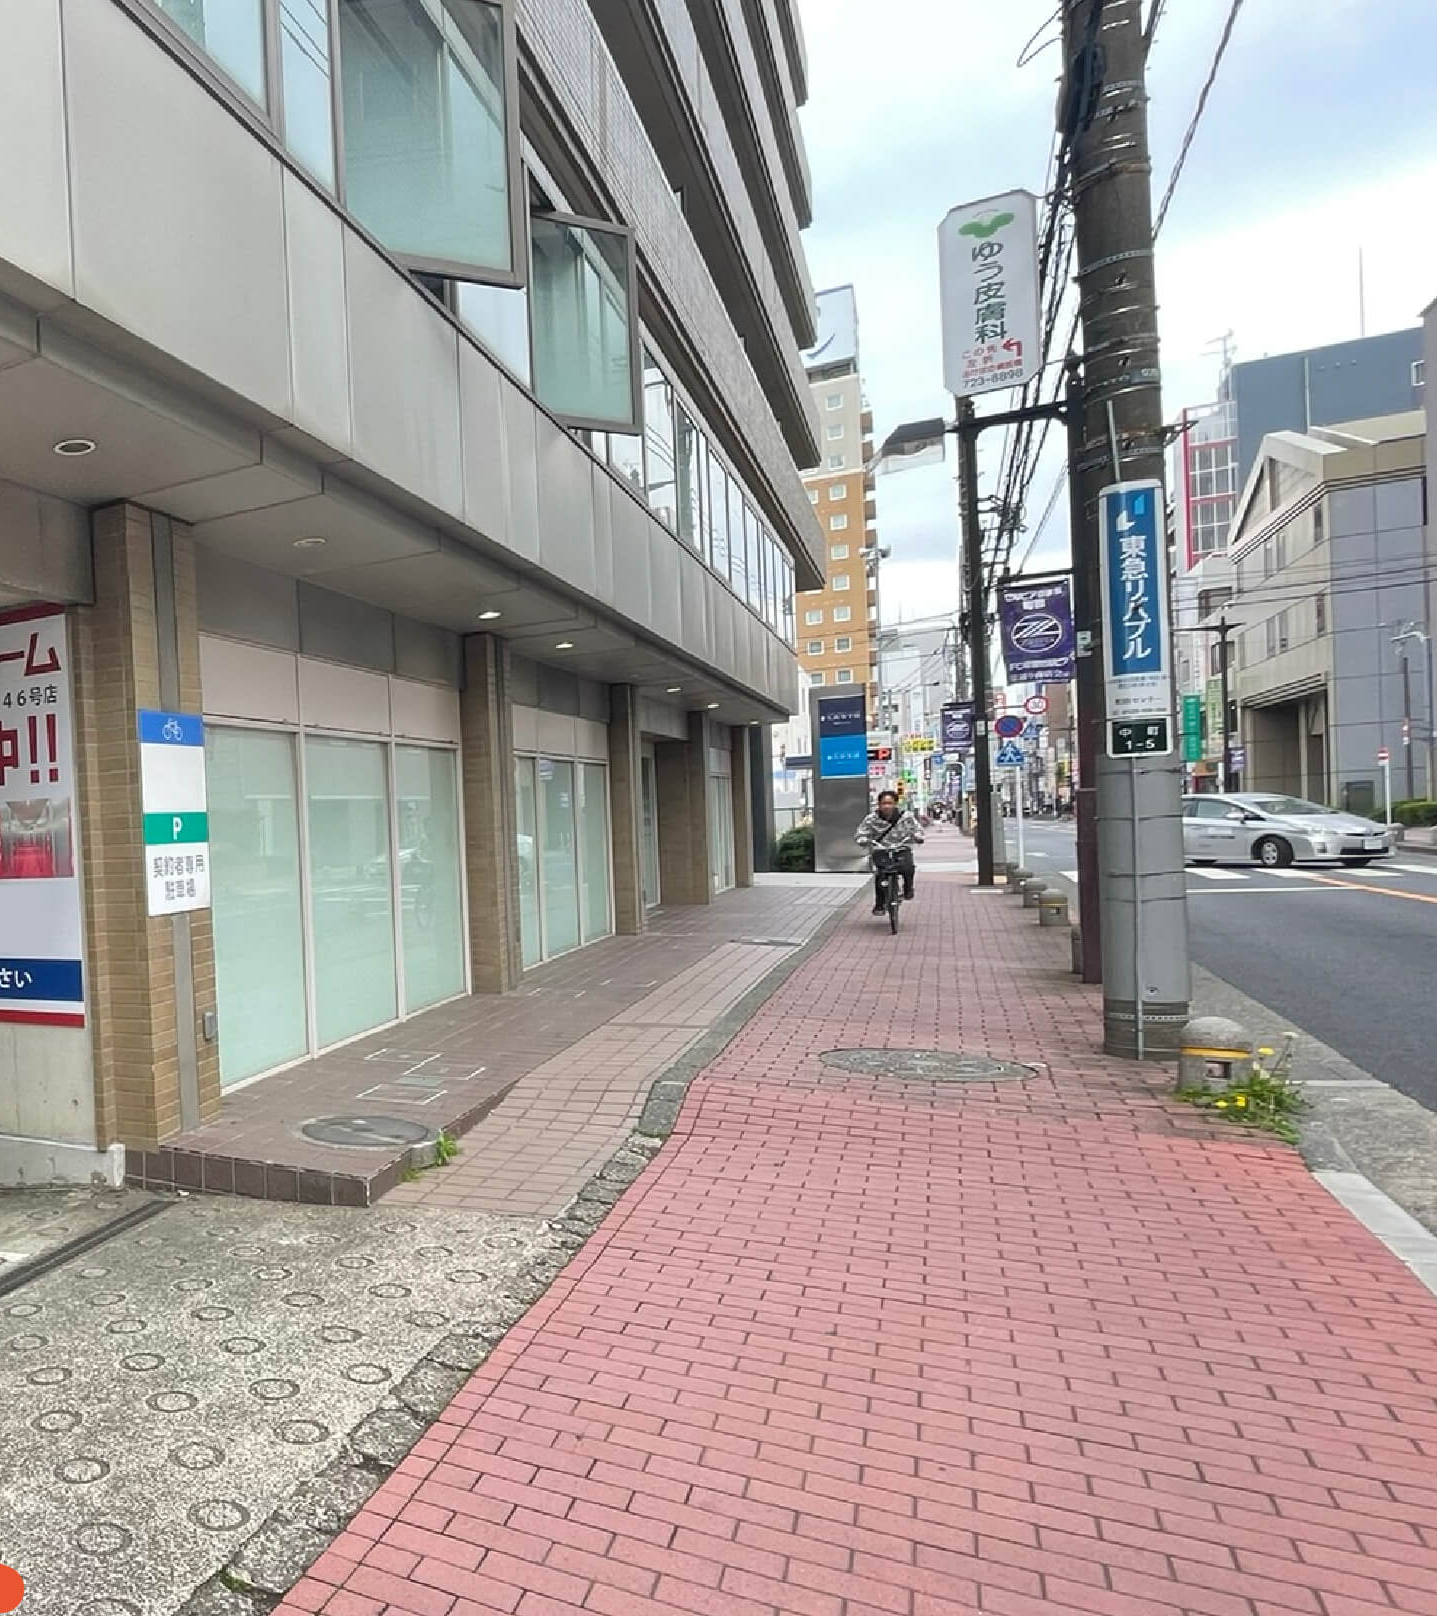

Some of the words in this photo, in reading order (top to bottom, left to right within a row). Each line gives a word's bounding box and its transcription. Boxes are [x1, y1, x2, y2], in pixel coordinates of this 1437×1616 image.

[972, 240, 1007, 344] ゆう皮膚科
[1119, 535, 1152, 661] 東急リバブル
[1124, 739, 1156, 751] 1-5
[172, 817, 183, 841] P
